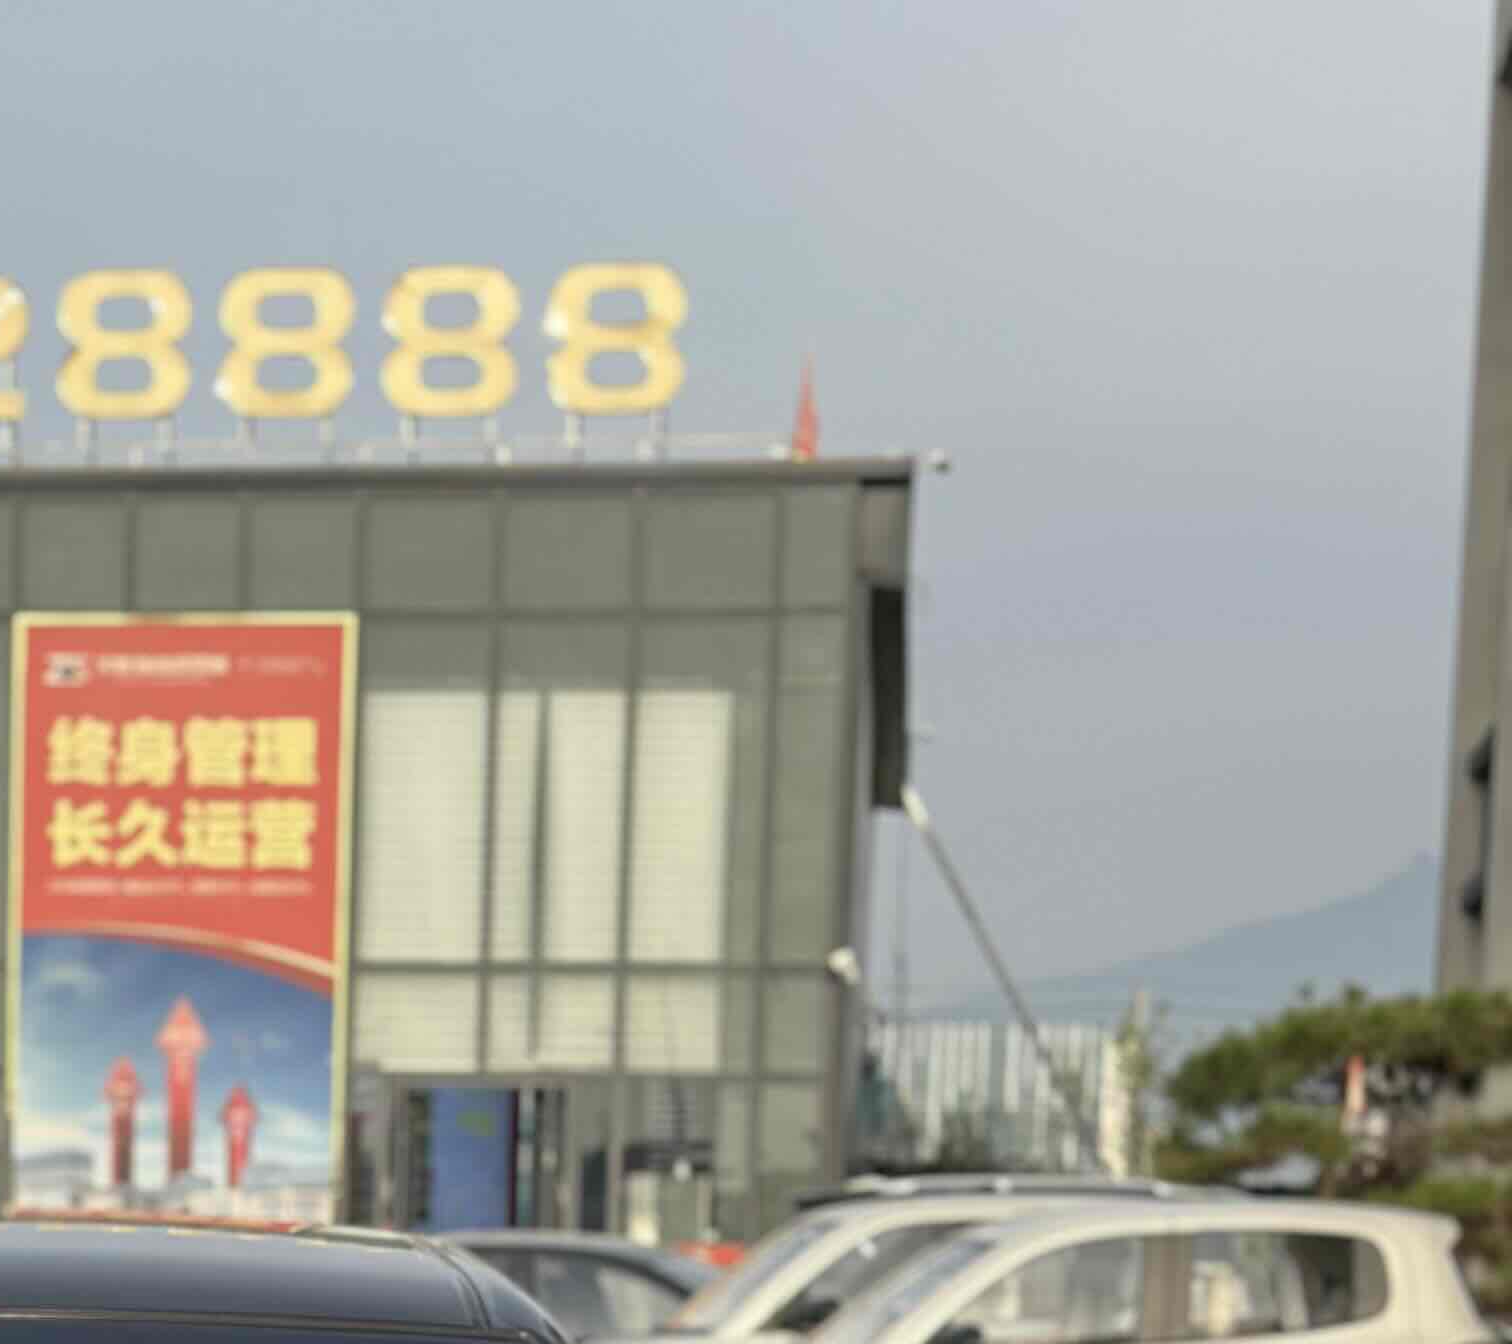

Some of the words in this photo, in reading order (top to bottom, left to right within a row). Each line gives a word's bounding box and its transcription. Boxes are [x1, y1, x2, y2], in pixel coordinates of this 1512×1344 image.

[46, 714, 320, 789] 终身管理
[46, 796, 318, 869] 长久运营
